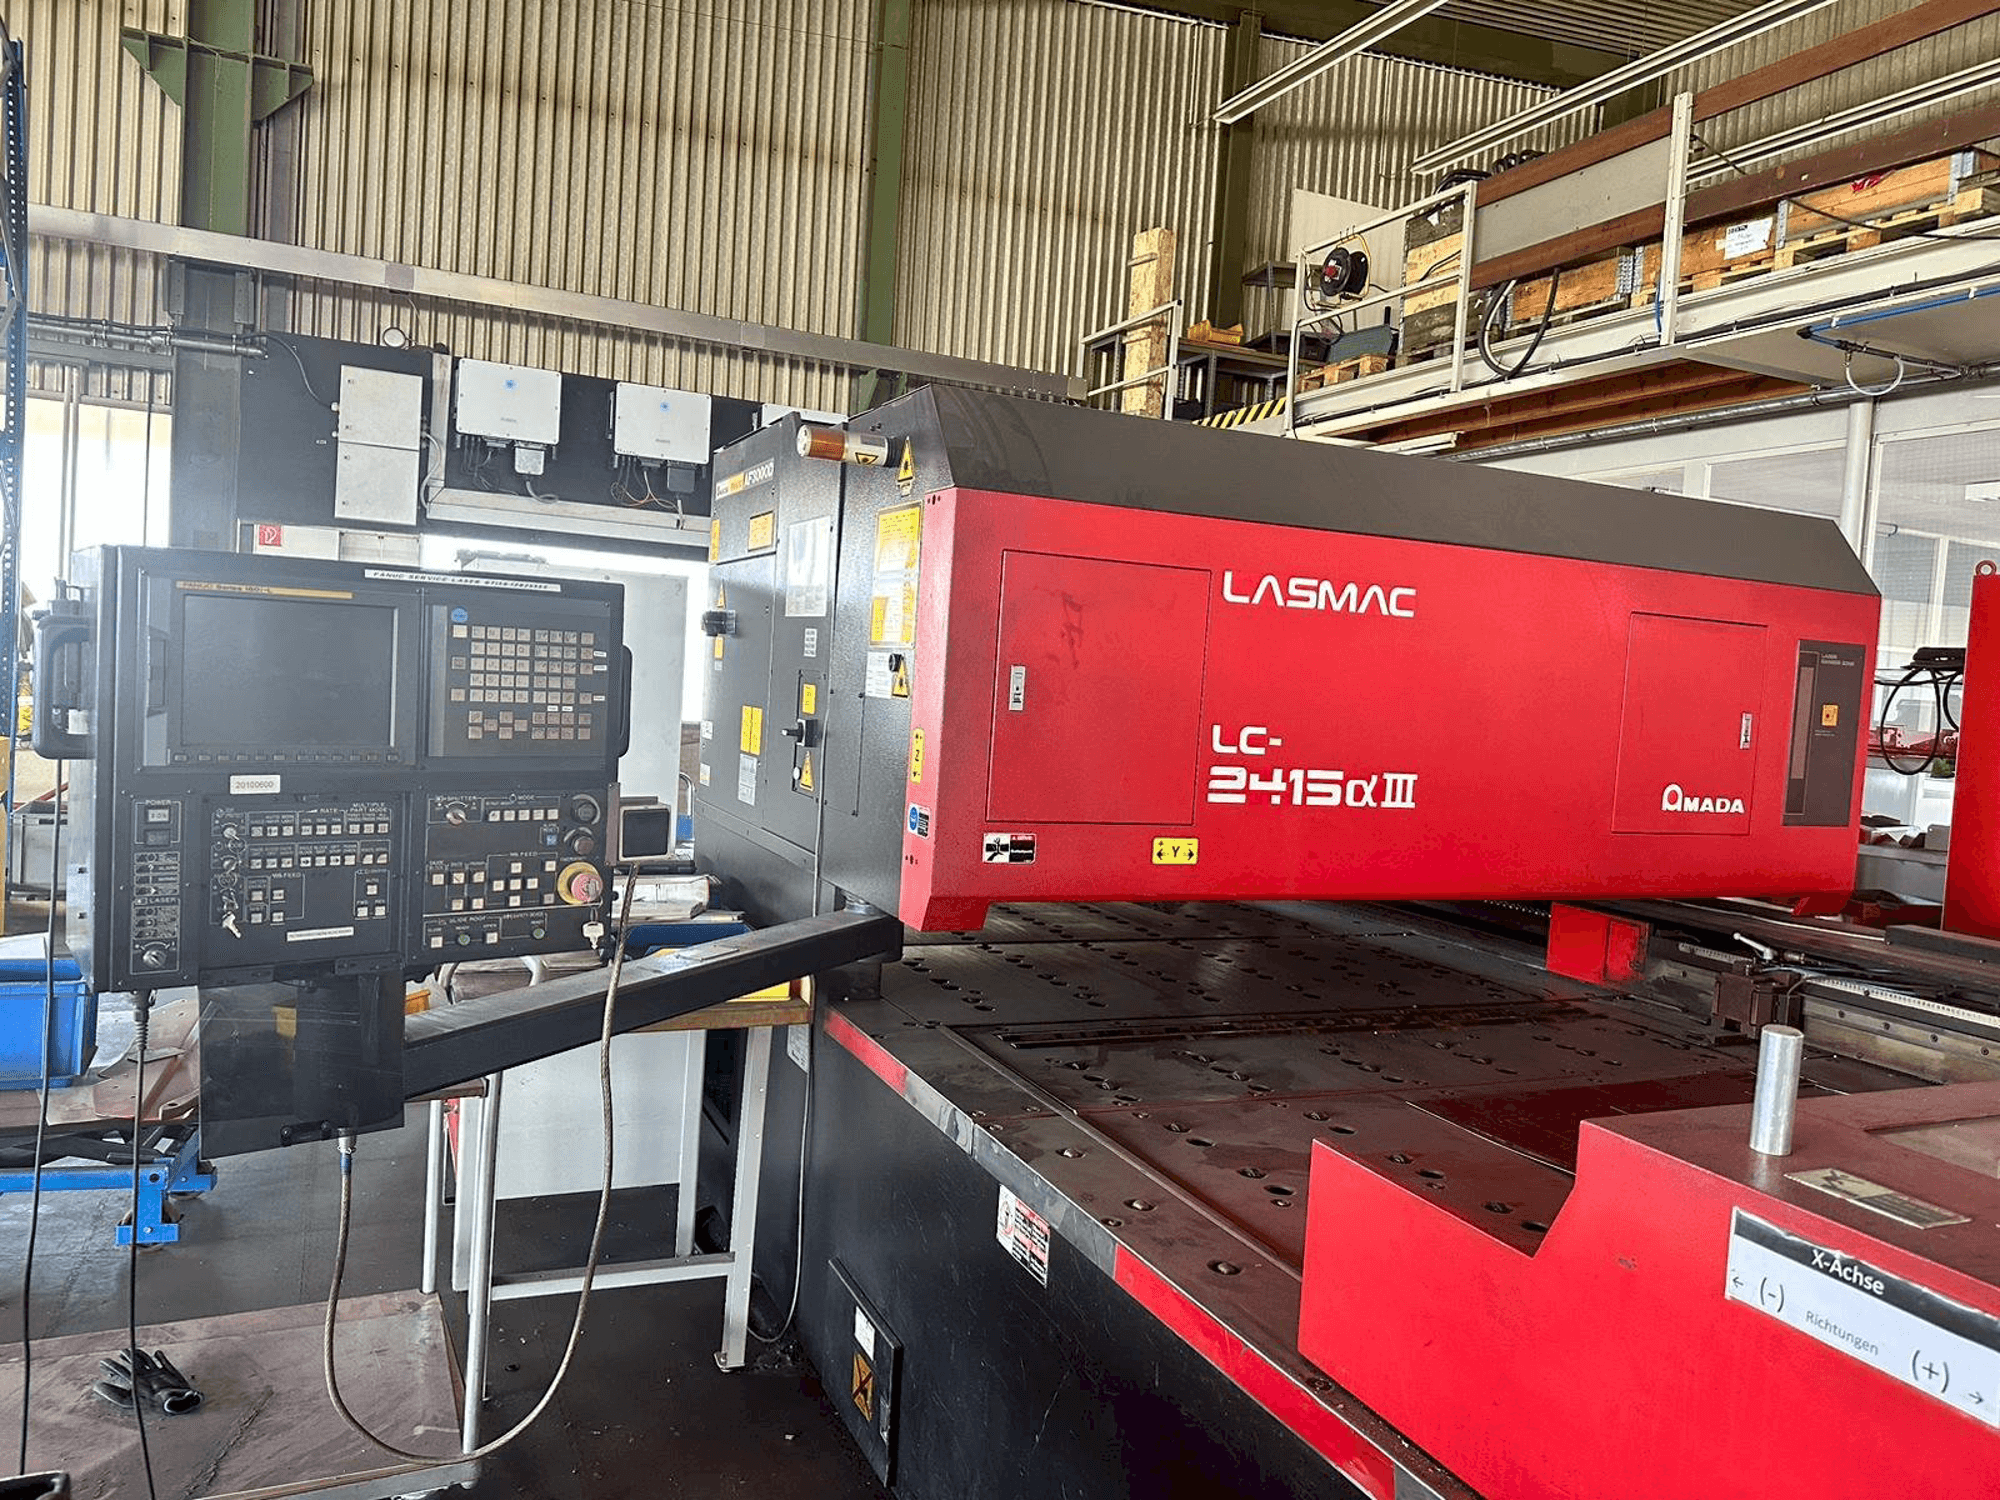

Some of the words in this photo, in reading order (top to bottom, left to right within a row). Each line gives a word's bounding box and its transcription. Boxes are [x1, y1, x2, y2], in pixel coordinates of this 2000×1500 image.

[373, 571, 404, 580] FANUC
[1222, 570, 1417, 618] LASMAC
[1211, 724, 1282, 755] LC-
[235, 780, 275, 790] 20100600
[1661, 783, 1746, 814] AMADA
[1171, 845, 1181, 858] Y
[1810, 1248, 1886, 1296] X-Achse
[1804, 1310, 1880, 1356] Richtungen
